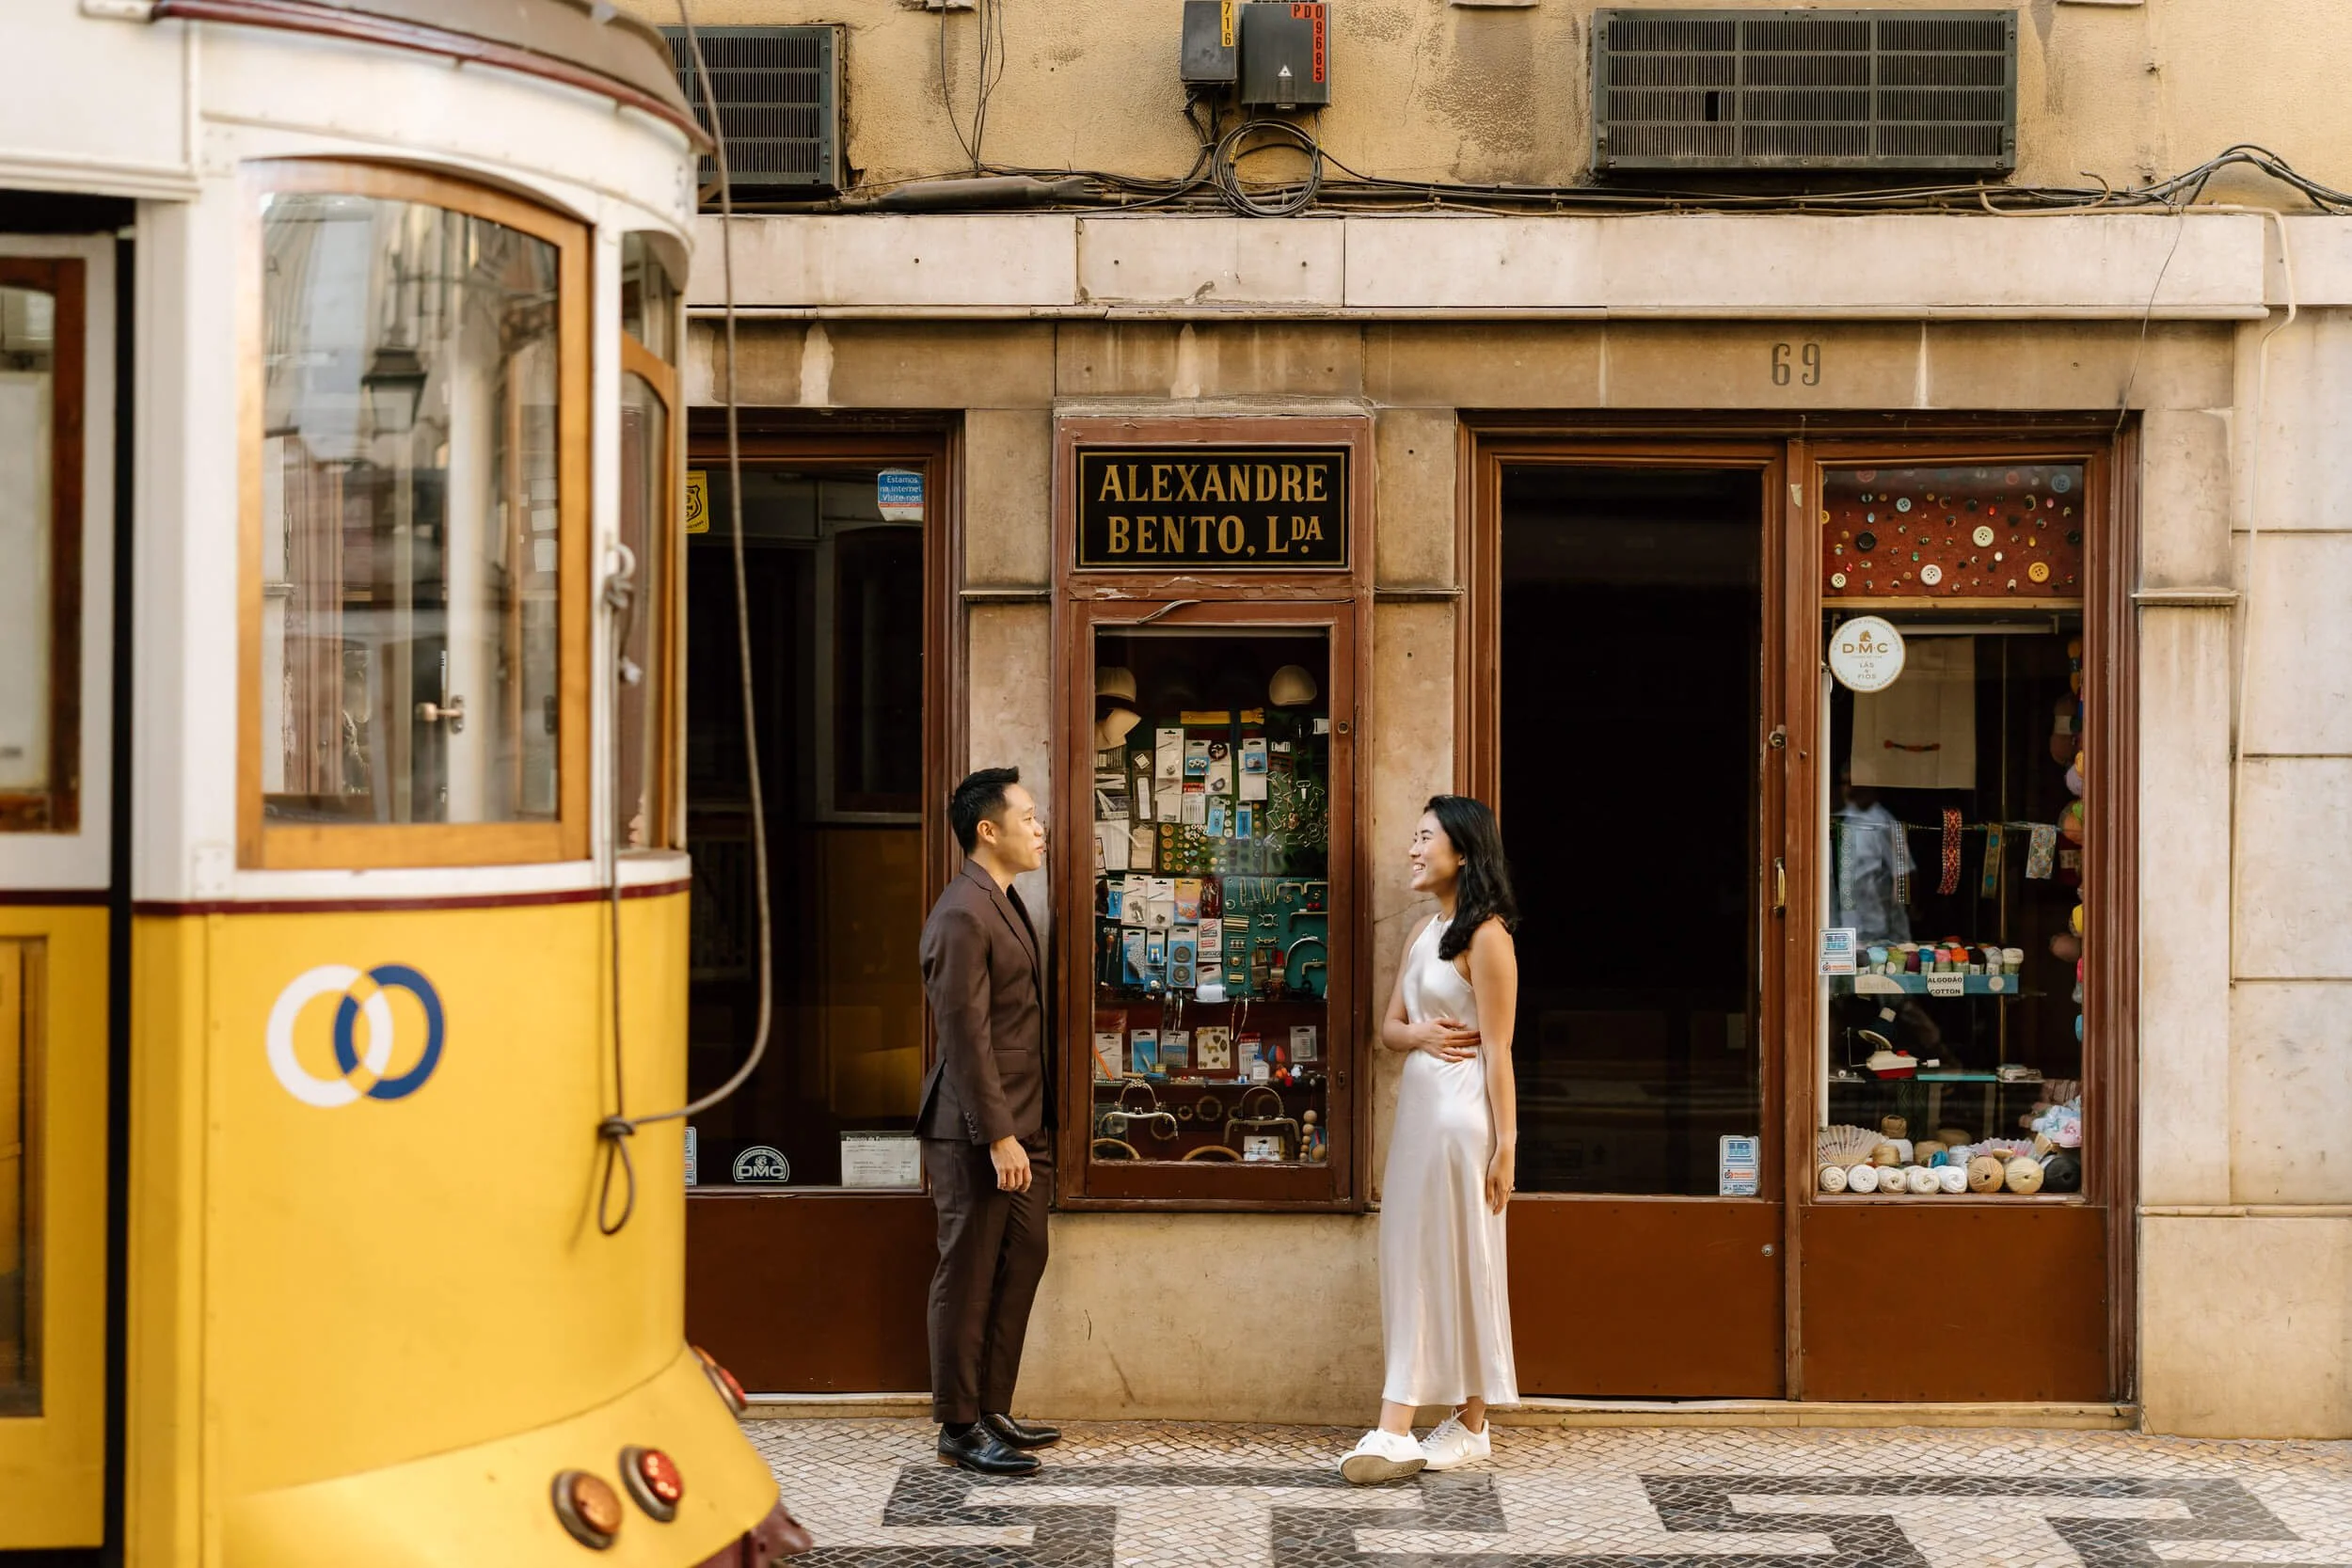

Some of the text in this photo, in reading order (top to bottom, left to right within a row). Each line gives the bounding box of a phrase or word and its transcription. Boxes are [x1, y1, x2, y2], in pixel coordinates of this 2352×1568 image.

[1772, 342, 1820, 387] 69
[886, 475, 918, 483] Estamos
[1098, 464, 1327, 503] ALEXANDRE
[1106, 515, 1257, 557] BENTO,
[1928, 975, 1963, 984] ALGODÃO
[737, 1165, 786, 1177] DMC
